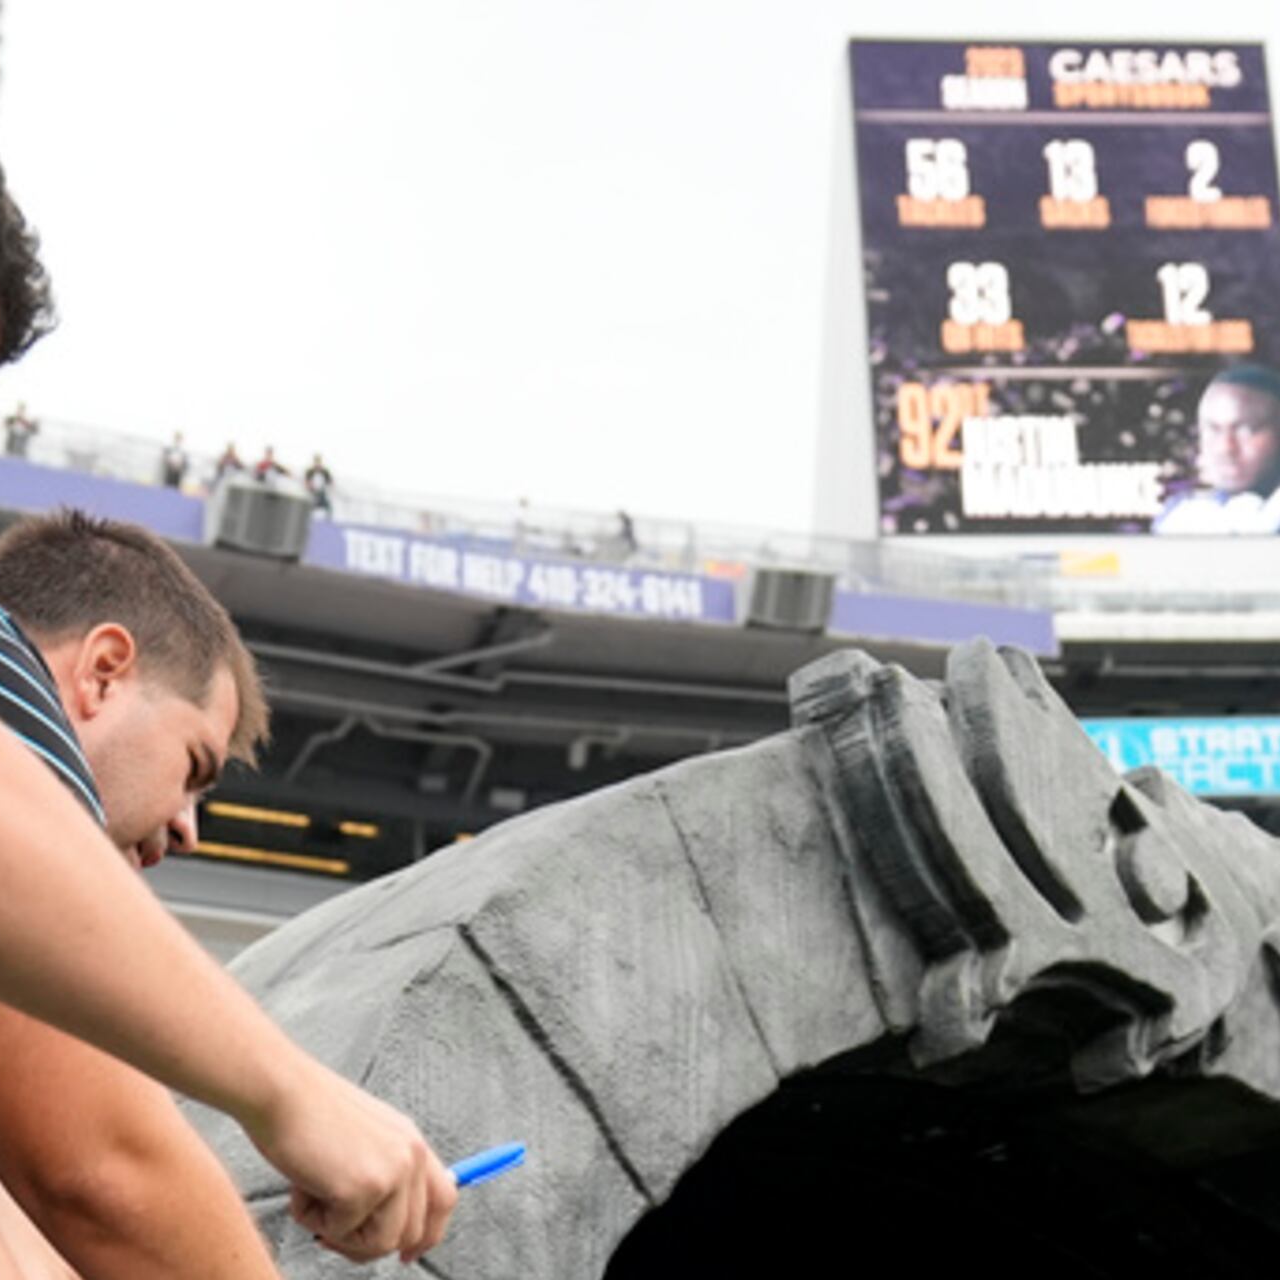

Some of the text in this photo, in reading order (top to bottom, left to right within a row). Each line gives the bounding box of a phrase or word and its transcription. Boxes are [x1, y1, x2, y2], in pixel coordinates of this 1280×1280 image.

[1049, 49, 1243, 89] CAESARS
[1185, 140, 1223, 202] 2
[1157, 262, 1213, 325] 12
[345, 530, 406, 578] TEXT
[410, 542, 461, 590] FOR
[463, 552, 522, 600] HELP
